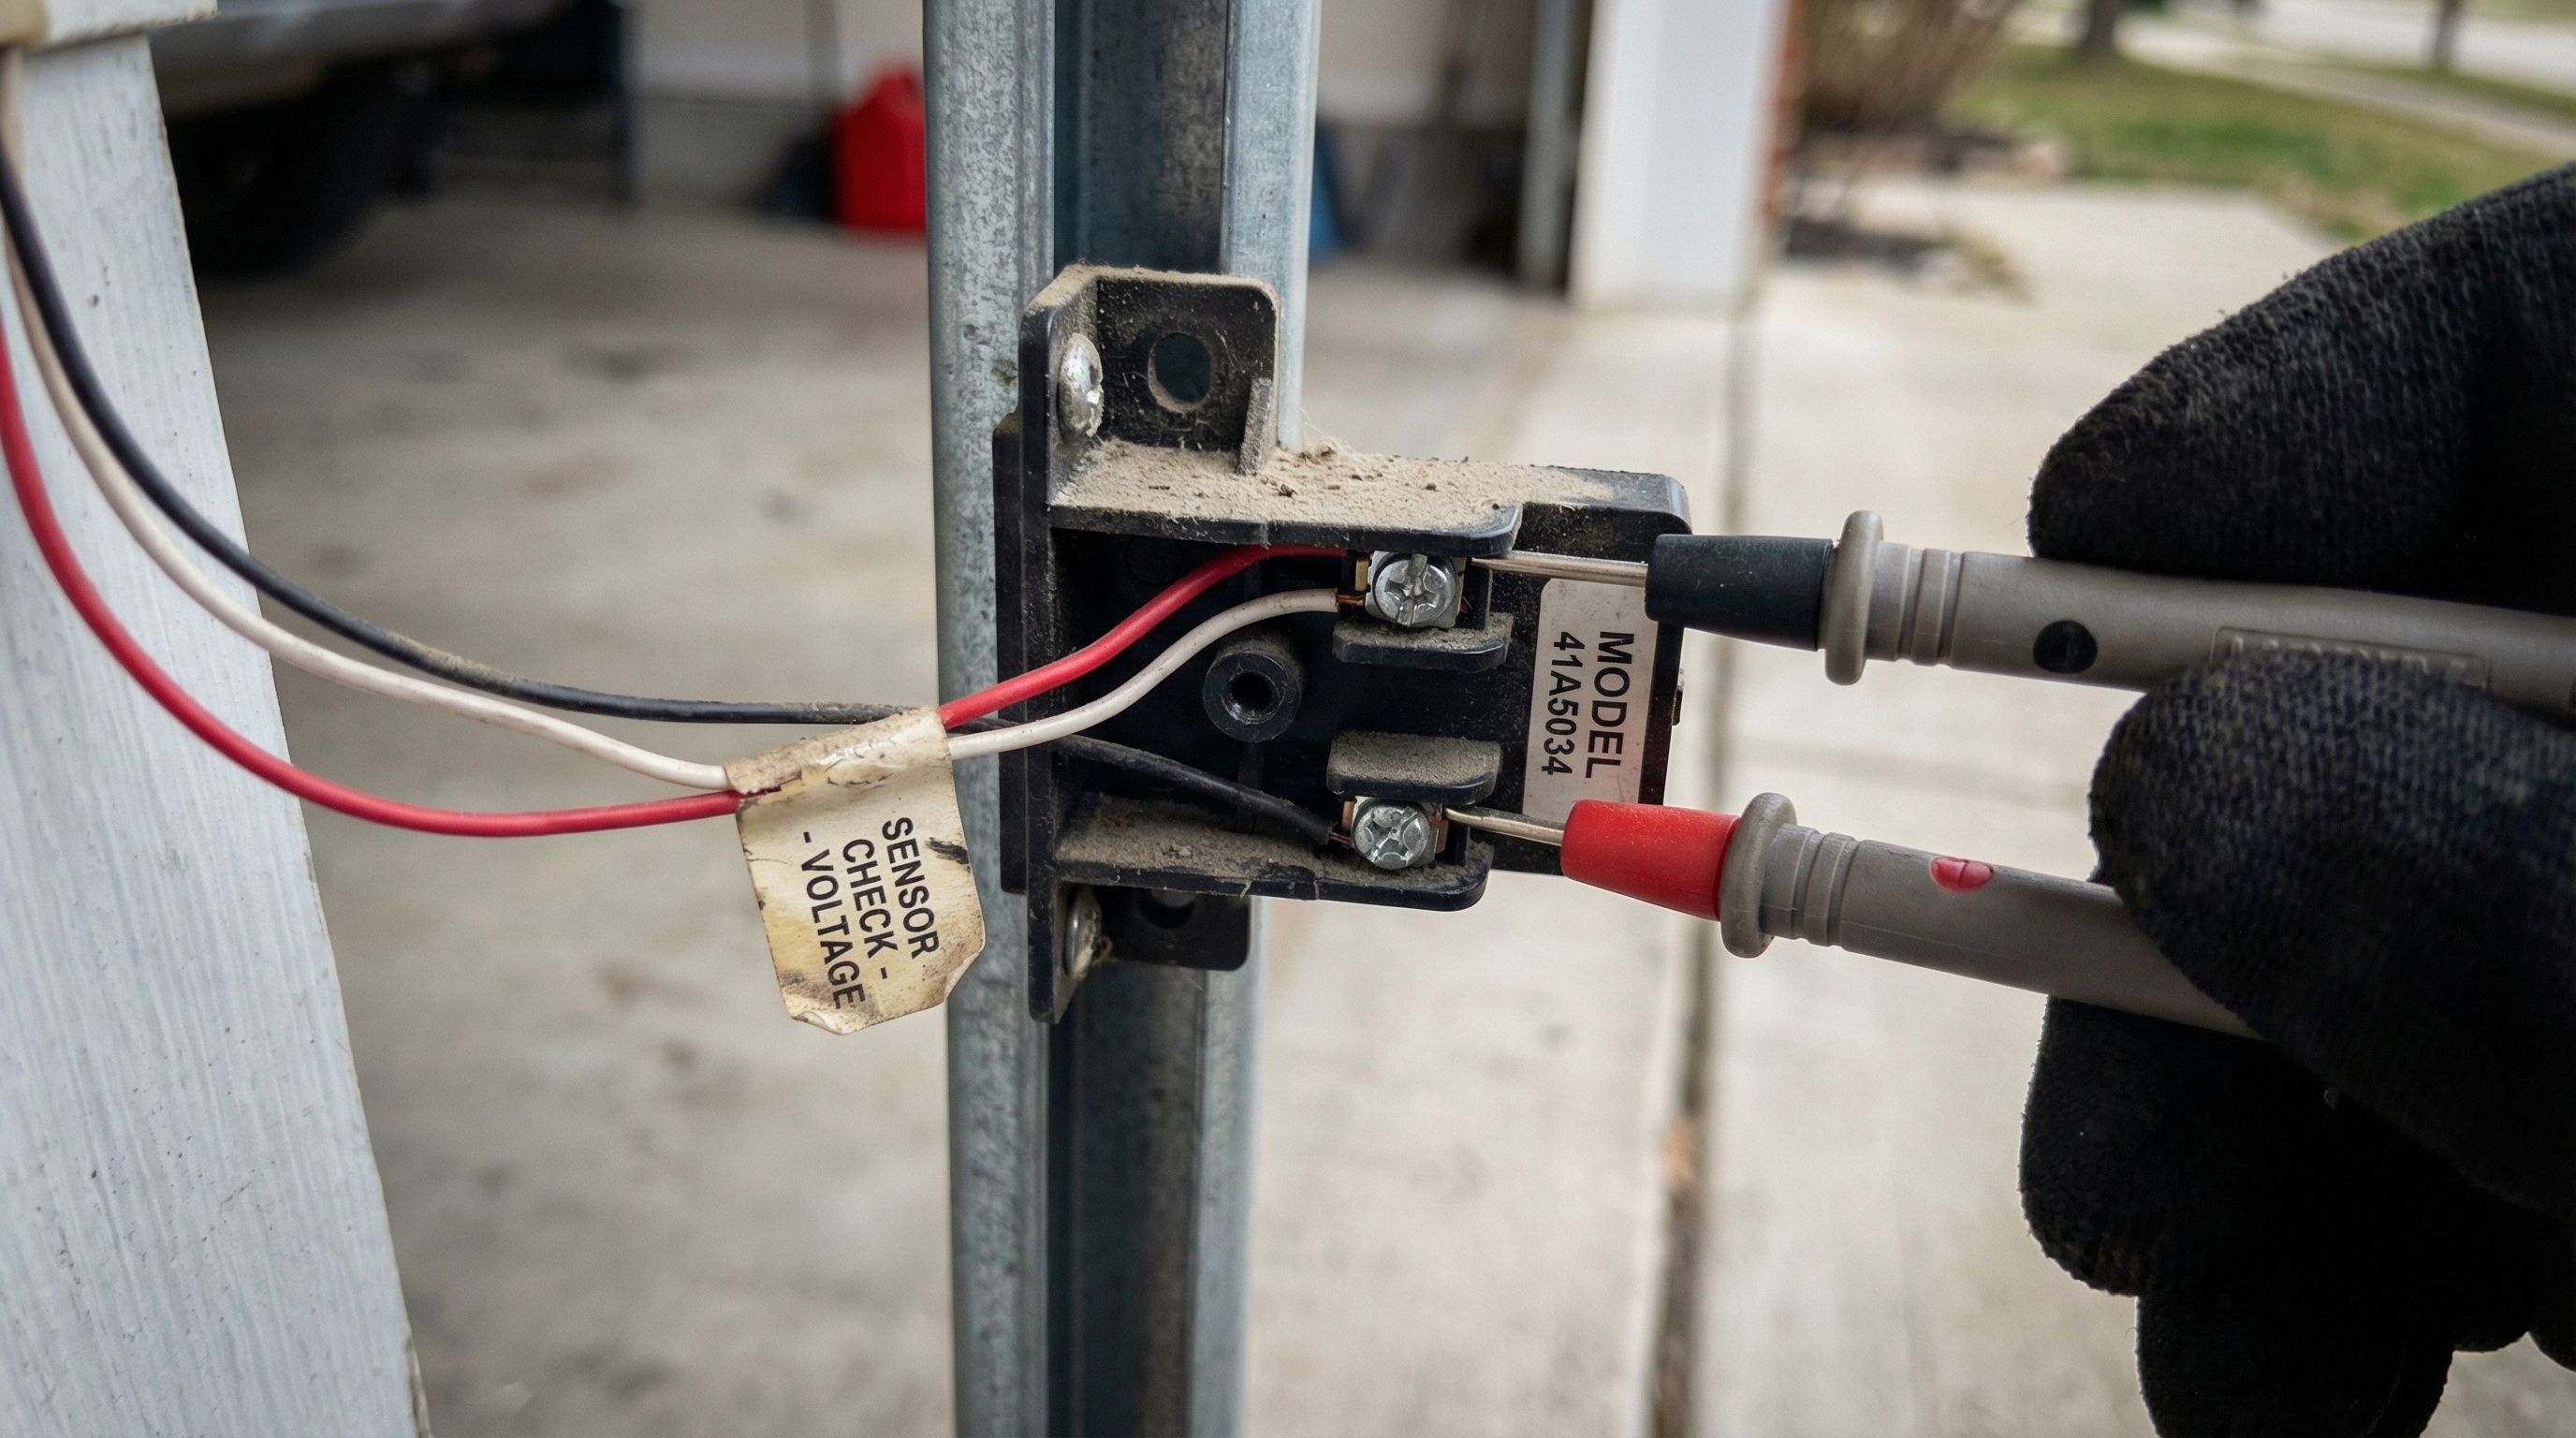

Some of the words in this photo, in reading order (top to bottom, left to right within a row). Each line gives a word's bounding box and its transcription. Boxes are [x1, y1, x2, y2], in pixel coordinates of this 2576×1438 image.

[1541, 631, 1585, 775] 41A5034
[1585, 631, 1635, 779] MODEL
[800, 848, 866, 1010] VOLTAGE
[842, 838, 899, 960] CHECK
[881, 816, 939, 959] SENSOR
